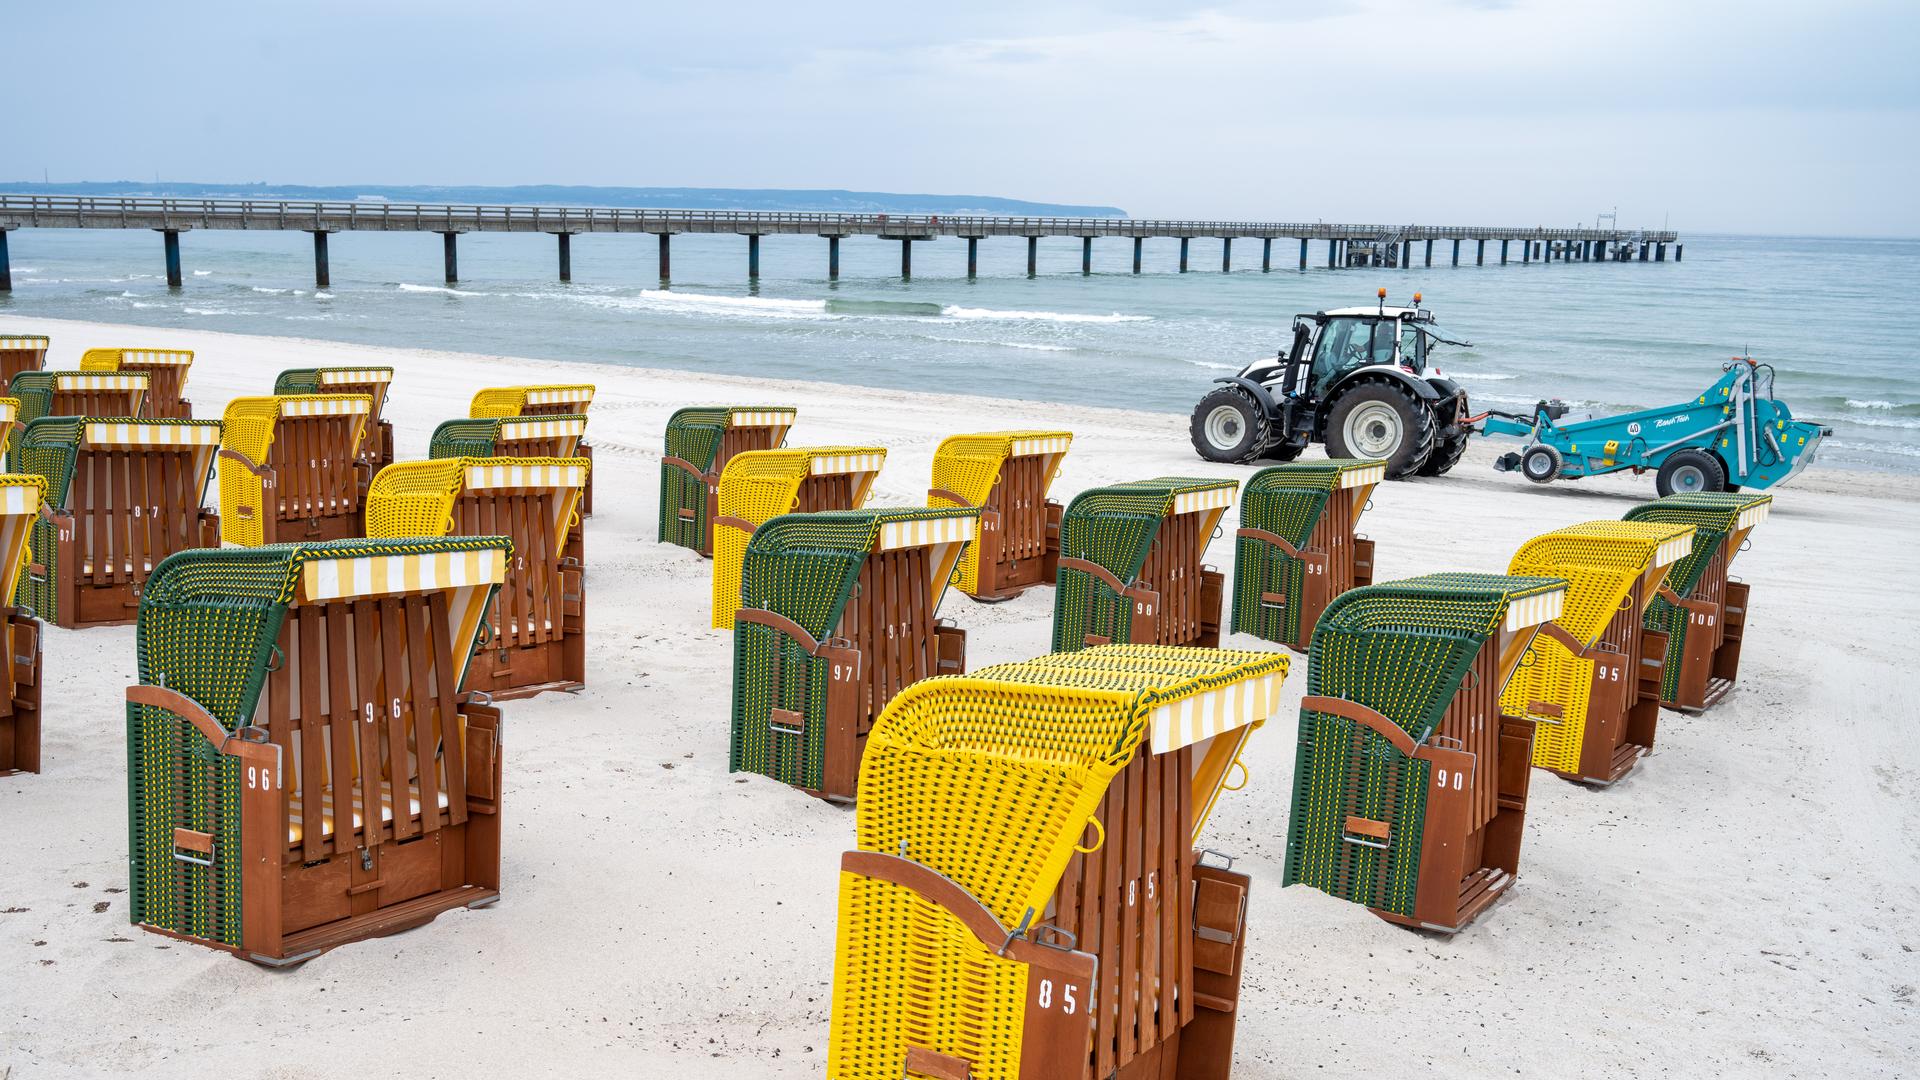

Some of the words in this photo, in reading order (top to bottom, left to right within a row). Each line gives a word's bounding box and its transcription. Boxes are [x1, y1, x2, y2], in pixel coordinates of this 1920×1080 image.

[1629, 424, 1639, 433] 40
[263, 479, 273, 488] 83
[984, 520, 995, 531] 94
[60, 529, 70, 542] 87
[1308, 563, 1322, 575] 99
[1137, 602, 1152, 616] 98
[1689, 612, 1714, 626] 100
[834, 664, 853, 682] 97
[1599, 666, 1619, 682] 95
[248, 766, 270, 791] 96
[1437, 769, 1463, 791] 90
[1038, 979, 1077, 1015] 85
